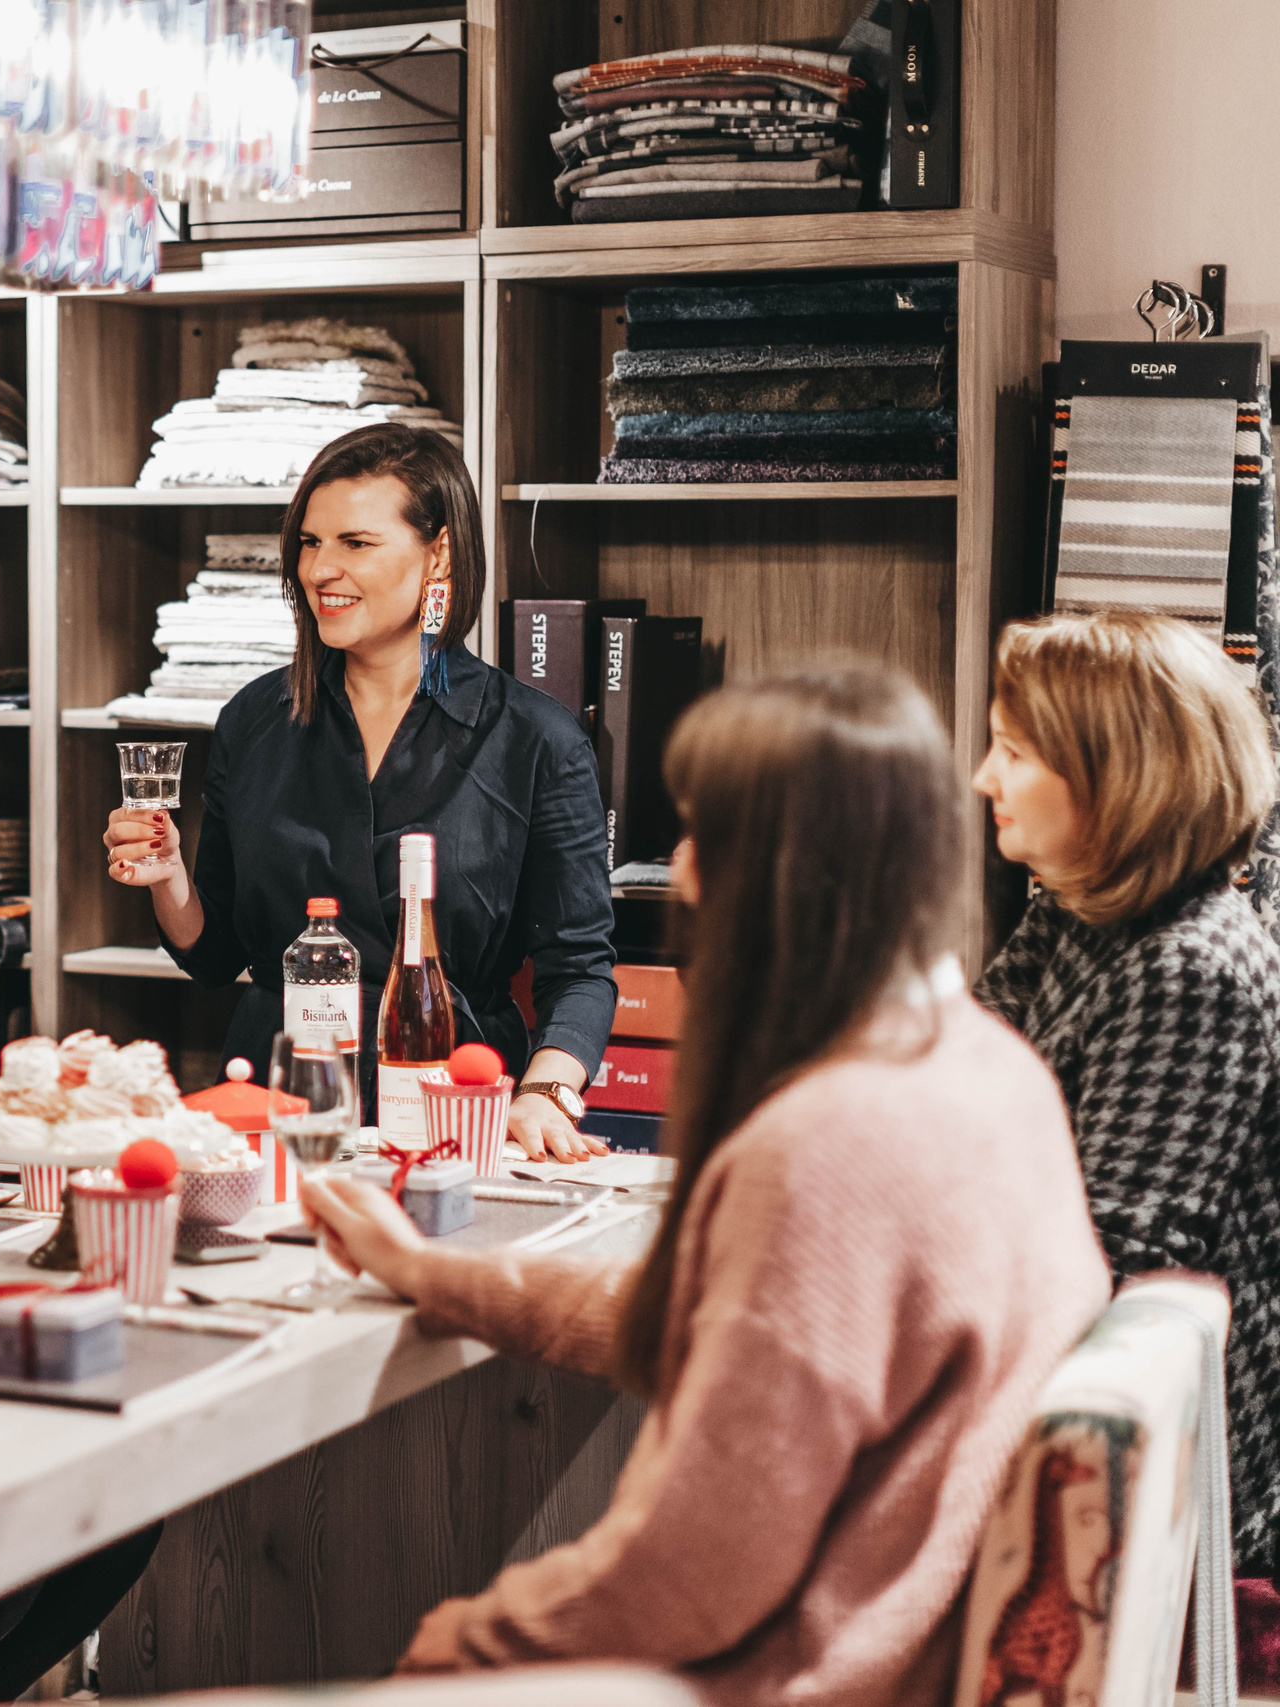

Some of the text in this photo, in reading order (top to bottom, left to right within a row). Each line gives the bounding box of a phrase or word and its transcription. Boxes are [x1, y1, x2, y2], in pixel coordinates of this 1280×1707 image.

[907, 45, 916, 82] MOON
[317, 89, 381, 104] de Le Cuona
[918, 151, 926, 186] INSPIRED
[318, 179, 352, 192] Cuona
[1131, 363, 1177, 374] DEDAR
[531, 613, 547, 678] STEPEVI
[607, 631, 624, 692] STEPEVI
[607, 809, 617, 840] COLOR
[409, 884, 417, 941] sorrymama
[618, 996, 640, 1009] Pure
[302, 1008, 348, 1021] Bismarck
[616, 1070, 639, 1084] Pure
